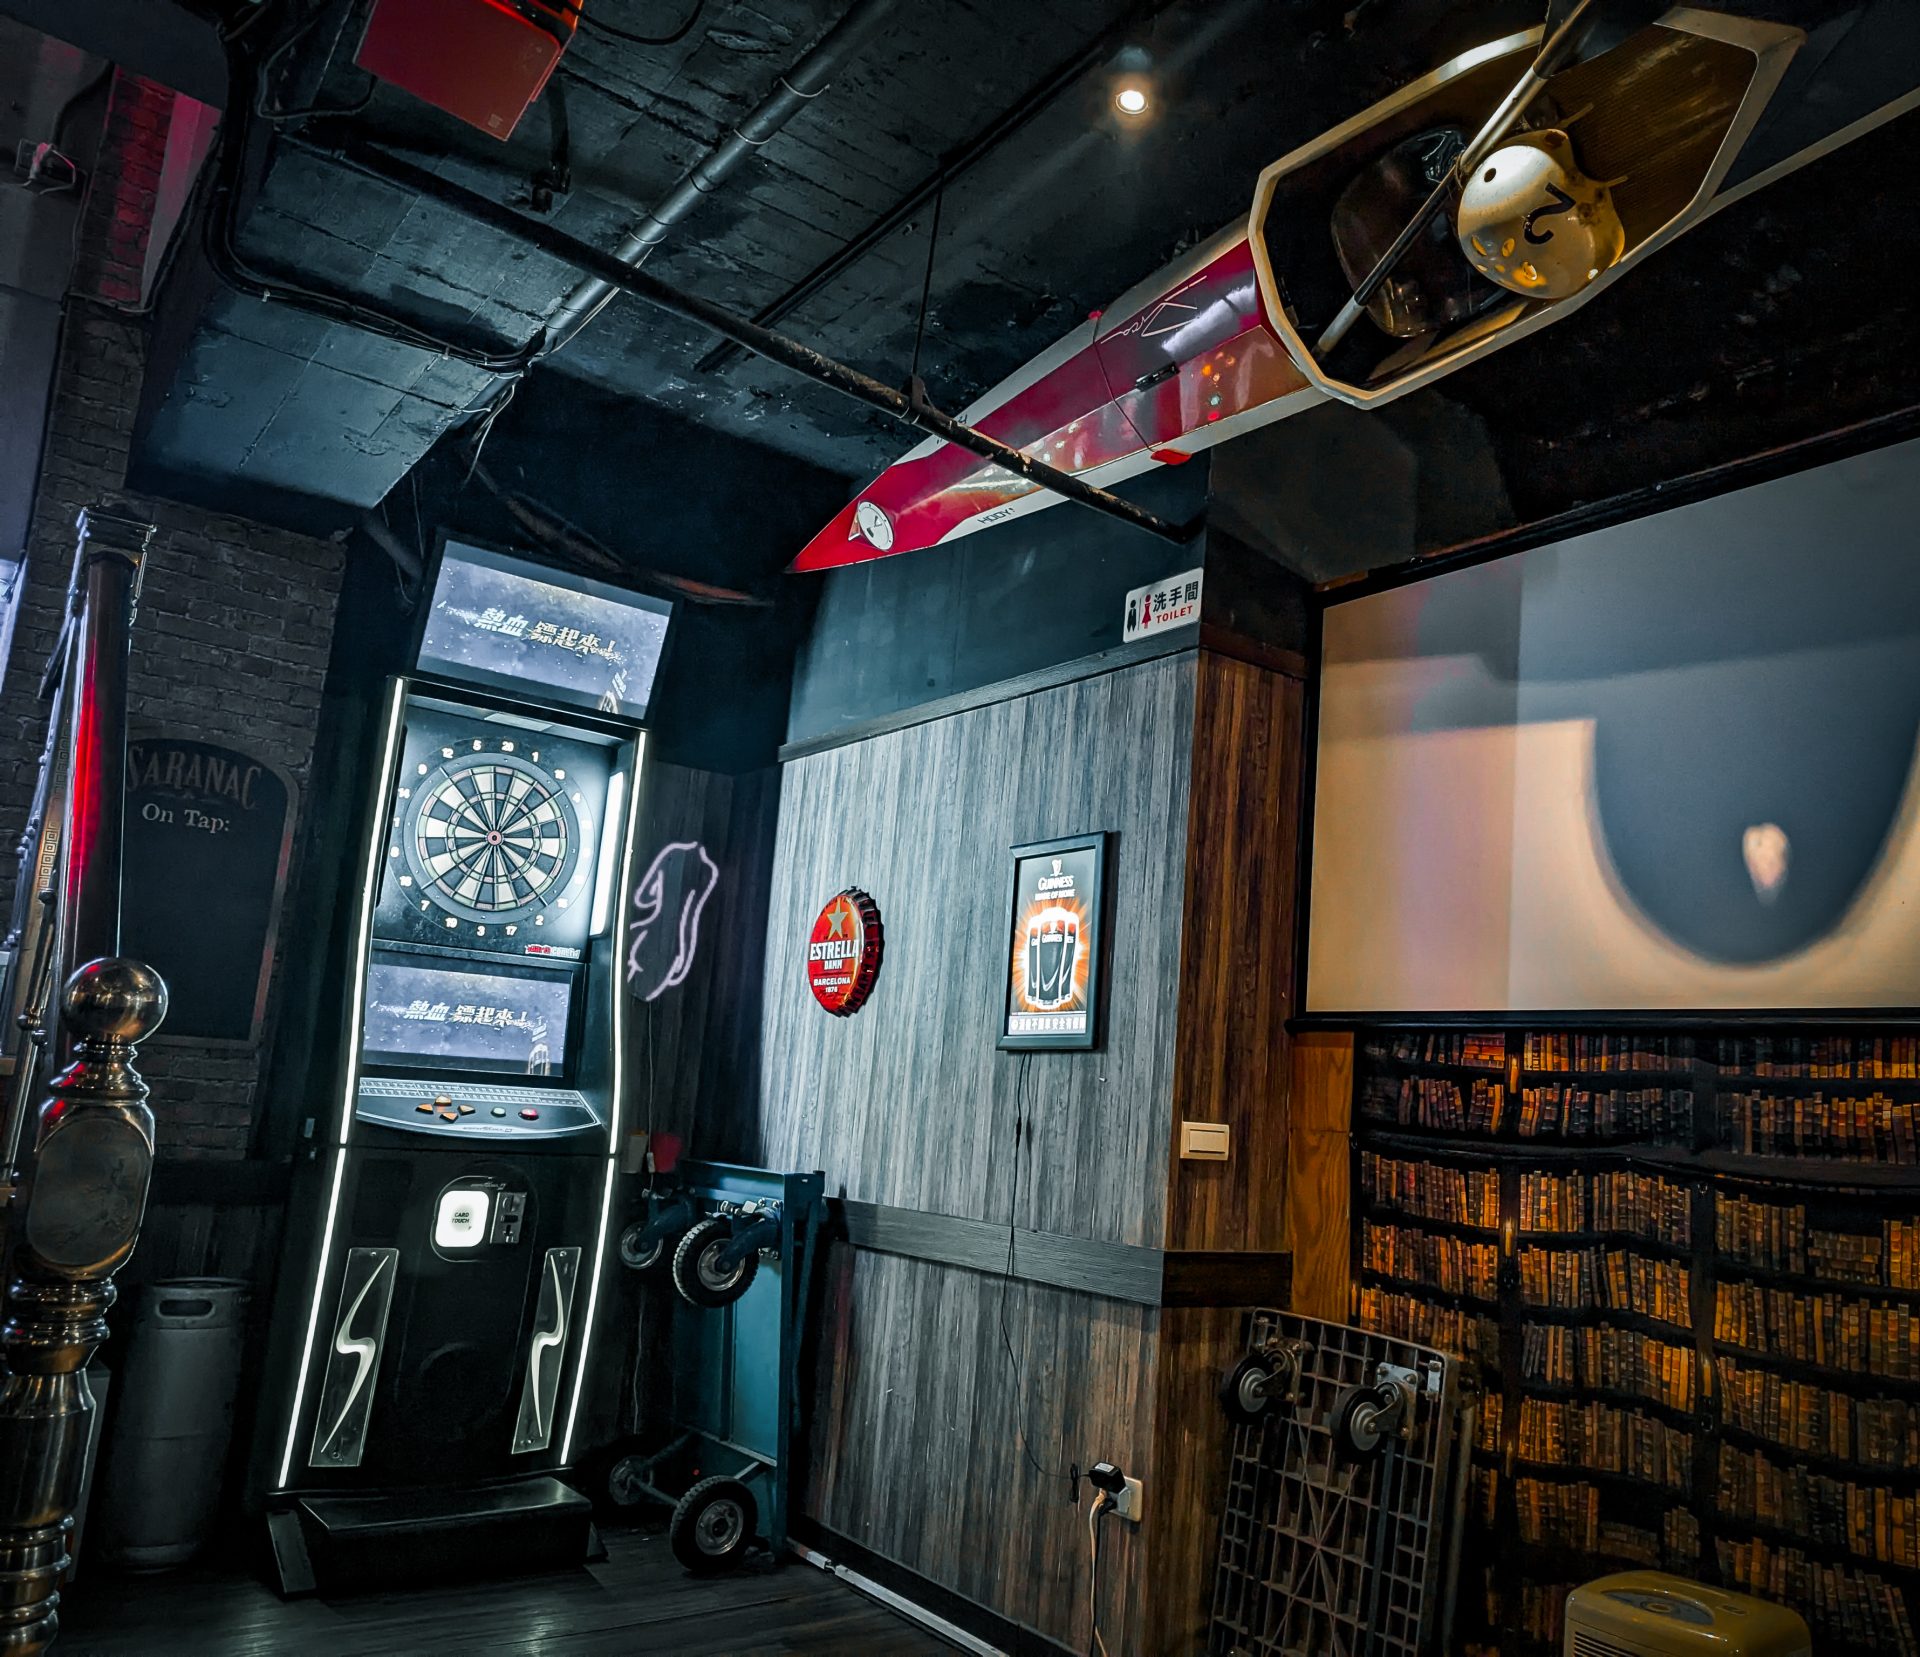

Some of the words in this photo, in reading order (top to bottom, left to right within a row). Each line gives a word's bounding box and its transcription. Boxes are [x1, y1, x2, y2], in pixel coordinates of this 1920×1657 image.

[1523, 181, 1577, 245] 2
[1152, 580, 1199, 613] 洗手間
[1156, 605, 1194, 624] TOILET
[473, 607, 529, 637] 熱血
[472, 739, 482, 751] 5
[501, 741, 515, 752] 20
[442, 747, 454, 759] 12
[532, 751, 539, 763] 1
[127, 746, 262, 811] SARANAC
[142, 803, 174, 823] On
[184, 809, 231, 835] Tap:
[420, 899, 430, 911] 7
[534, 914, 544, 926] 2
[476, 925, 486, 937] 3
[505, 925, 518, 937] 17
[809, 939, 860, 961] ESTRELLA
[813, 976, 851, 987] BARCELONA
[403, 1000, 450, 1022] 熱血
